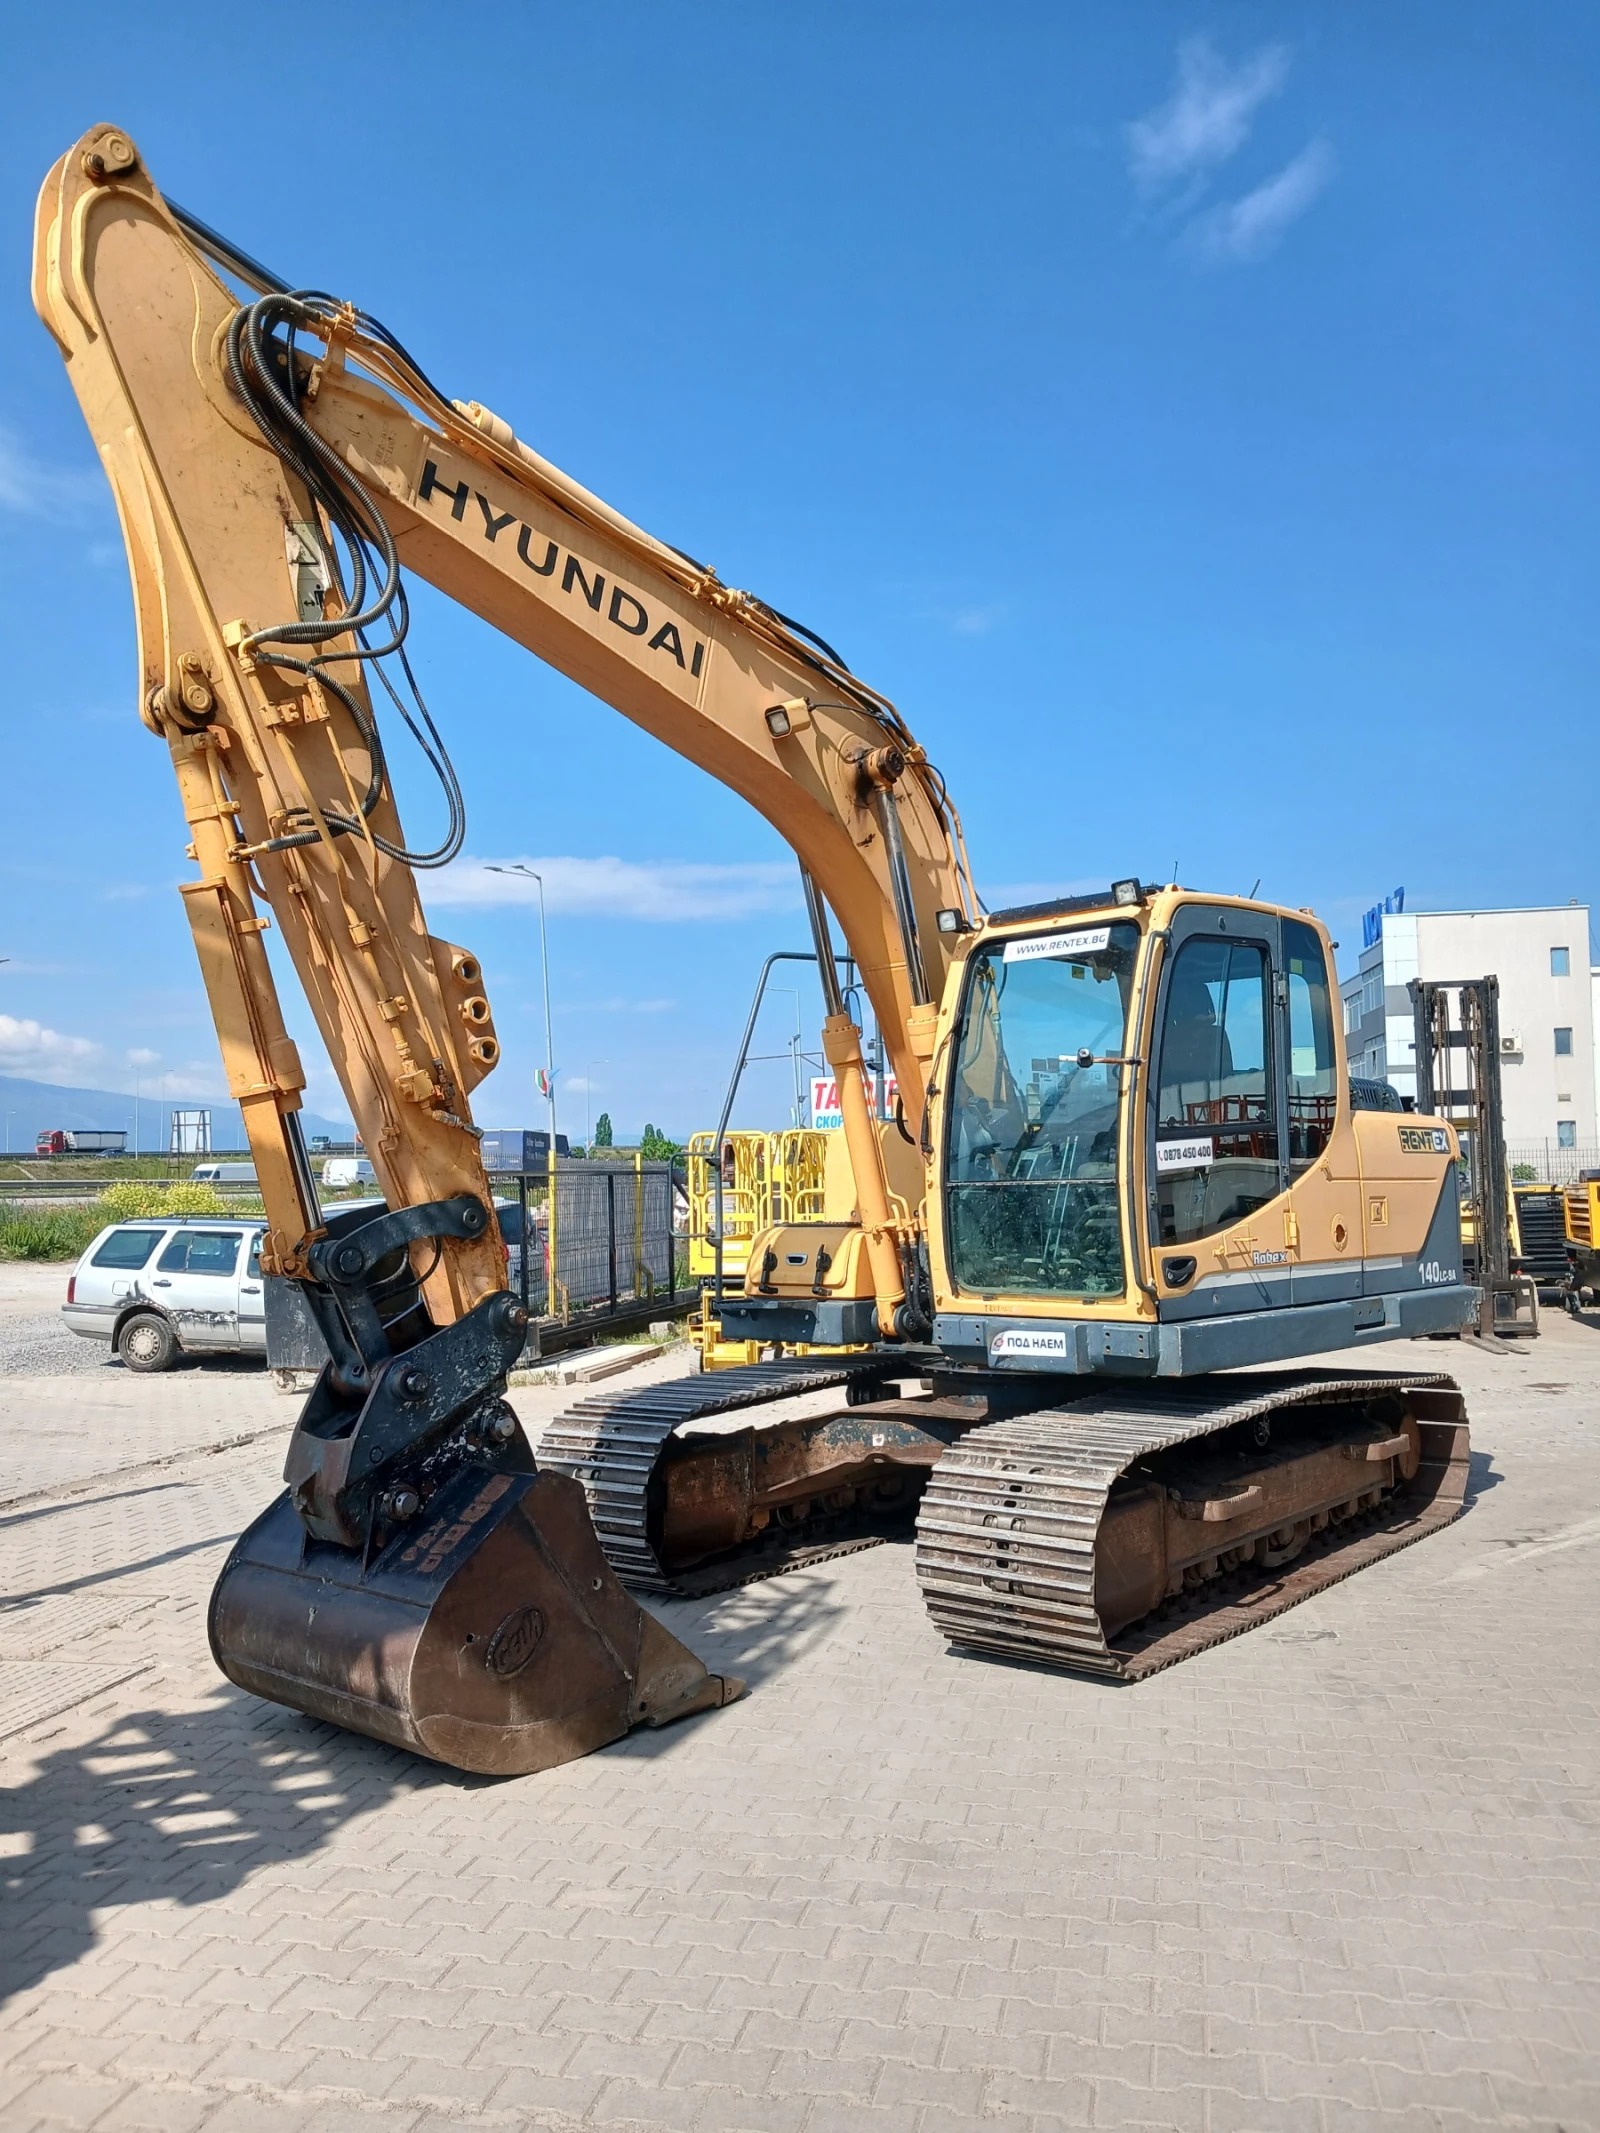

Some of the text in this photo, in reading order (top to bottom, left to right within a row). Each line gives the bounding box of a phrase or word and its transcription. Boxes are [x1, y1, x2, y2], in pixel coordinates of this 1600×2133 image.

[418, 459, 705, 679] HYUNDAI
[1016, 934, 1106, 955] WWW.RENTEX.BG
[1400, 1130, 1450, 1151] RENTEX
[1163, 1145, 1211, 1161] 0878 450 400
[1007, 1337, 1064, 1349] ПОД НАЕМ
